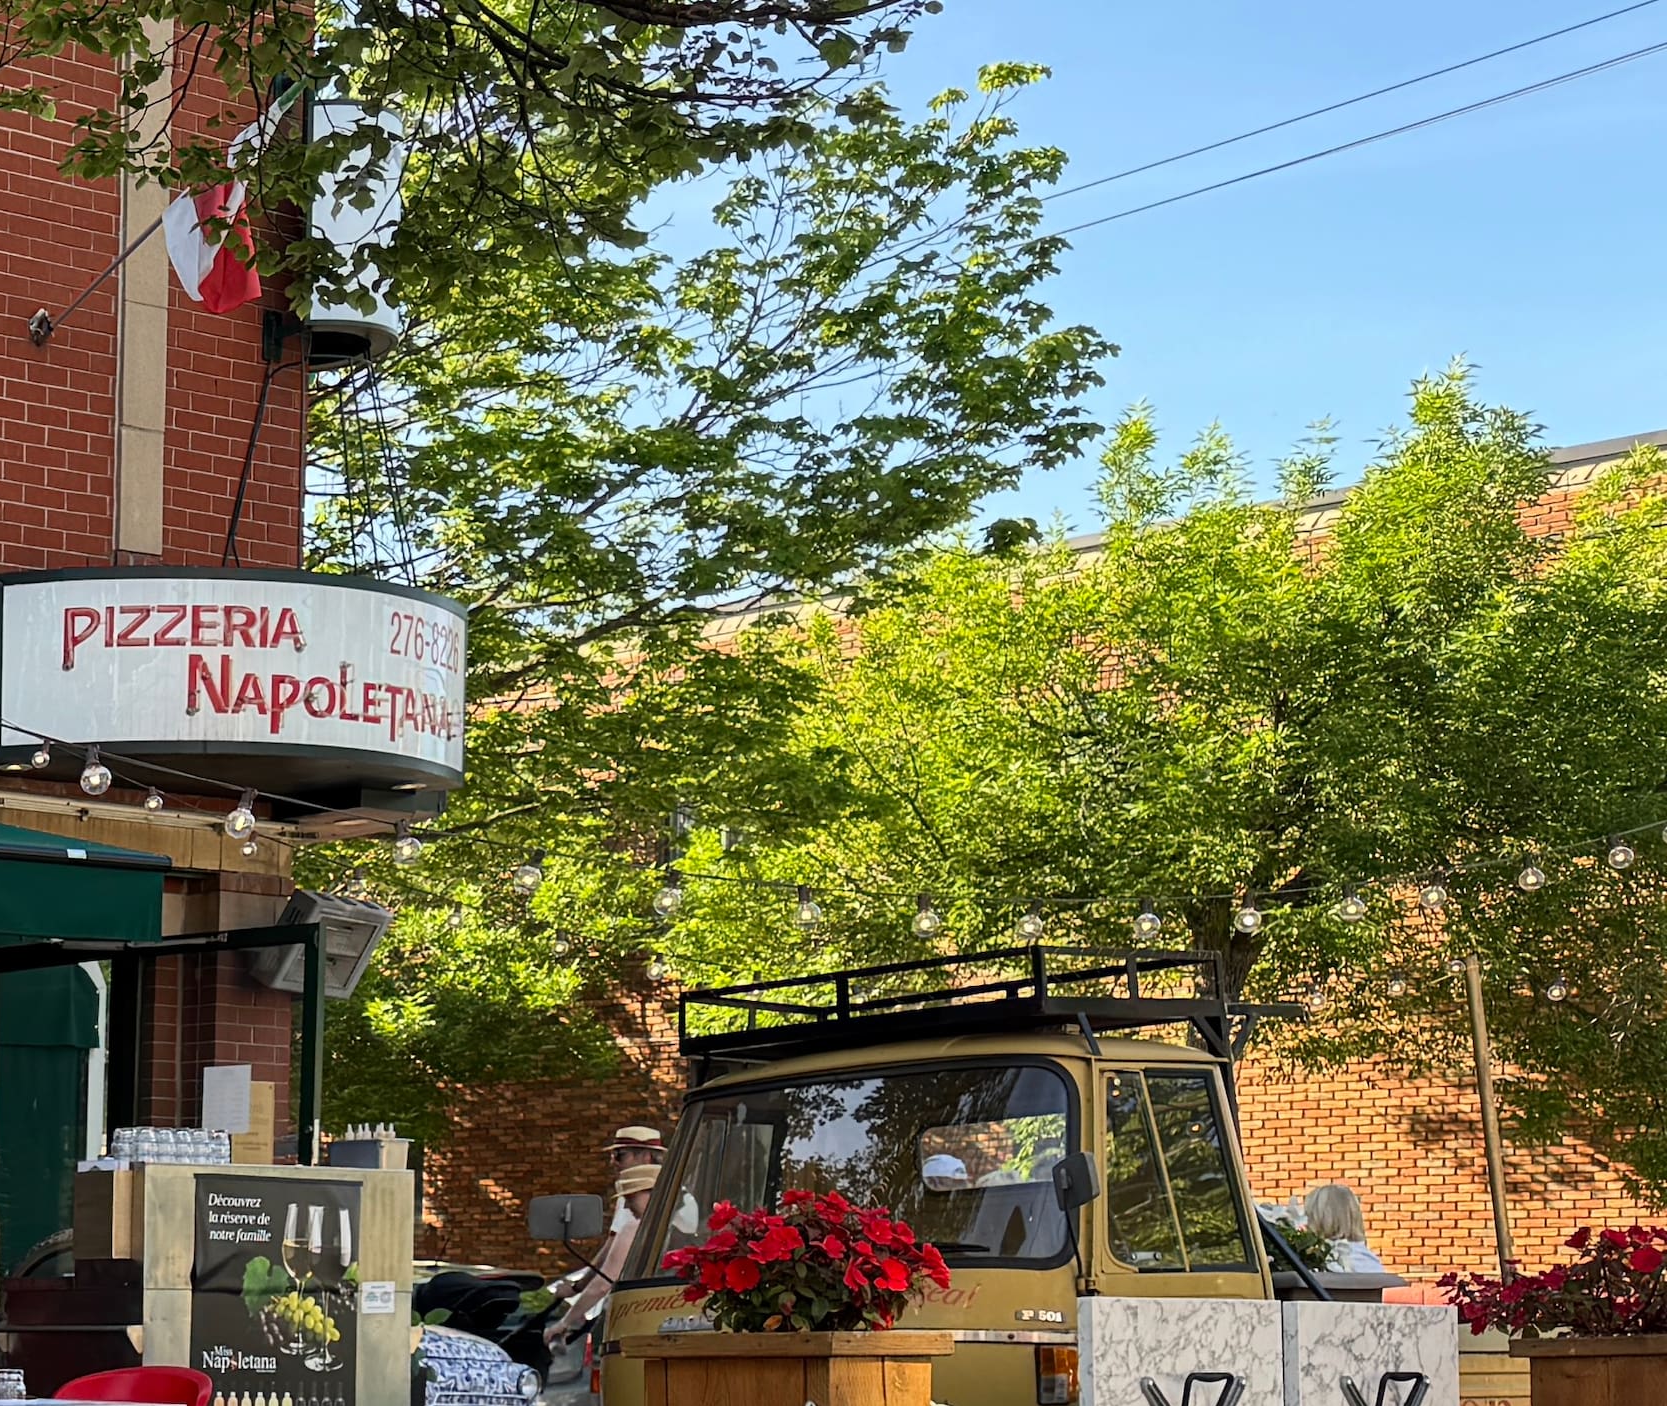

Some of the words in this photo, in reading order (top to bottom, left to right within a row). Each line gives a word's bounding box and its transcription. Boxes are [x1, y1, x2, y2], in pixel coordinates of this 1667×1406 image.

[62, 604, 307, 672] PIZZERIA
[390, 610, 460, 675] 276-8226
[185, 653, 453, 742] NAPOLETANA
[207, 1192, 262, 1209] Découvrez
[208, 1210, 218, 1224] la
[219, 1211, 256, 1225] réserve
[257, 1213, 271, 1226] de
[209, 1230, 235, 1241] notre
[235, 1228, 272, 1244] famille
[1037, 1310, 1064, 1323] 501
[213, 1345, 234, 1357] Miss
